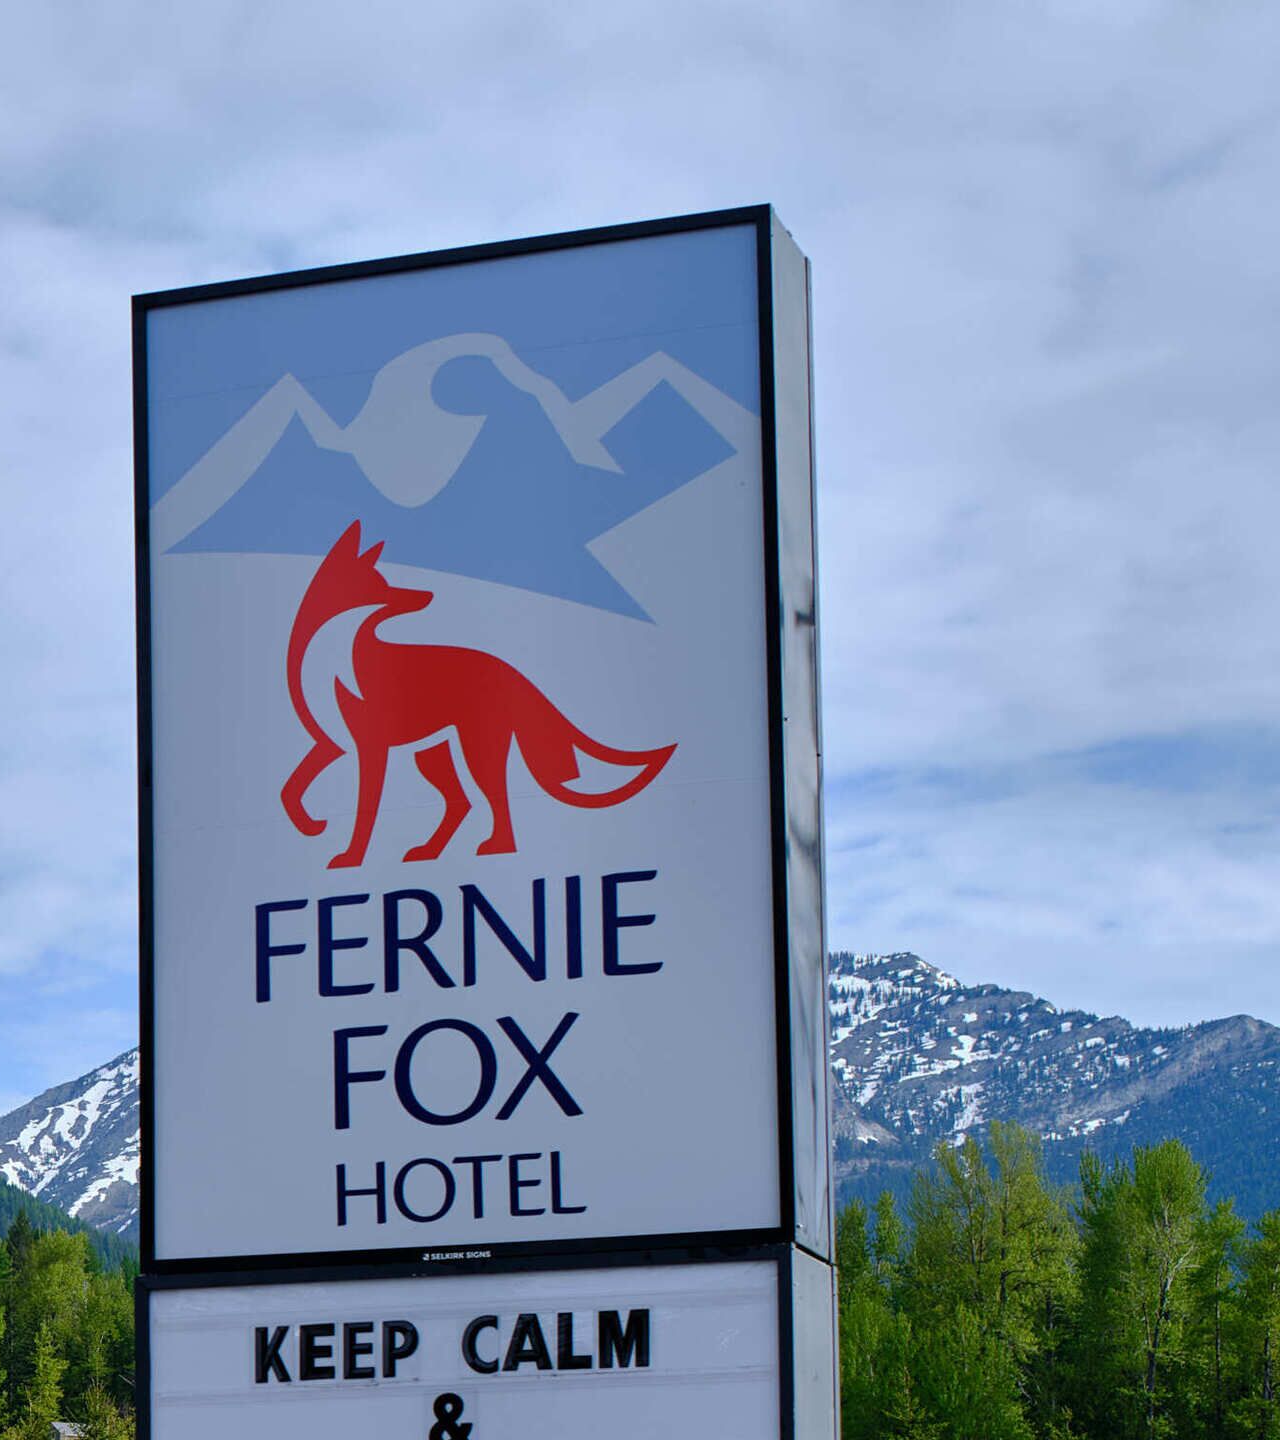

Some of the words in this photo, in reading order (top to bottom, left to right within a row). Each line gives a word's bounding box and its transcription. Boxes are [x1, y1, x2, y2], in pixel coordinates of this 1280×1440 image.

[254, 868, 663, 1003] FERNIE
[333, 1011, 584, 1130] FOX
[335, 1150, 588, 1227] HOTEL
[430, 1252, 464, 1261] SELKIRK
[466, 1250, 492, 1260] SIGNS
[254, 1319, 420, 1384] KEEP
[461, 1307, 651, 1375] CALM
